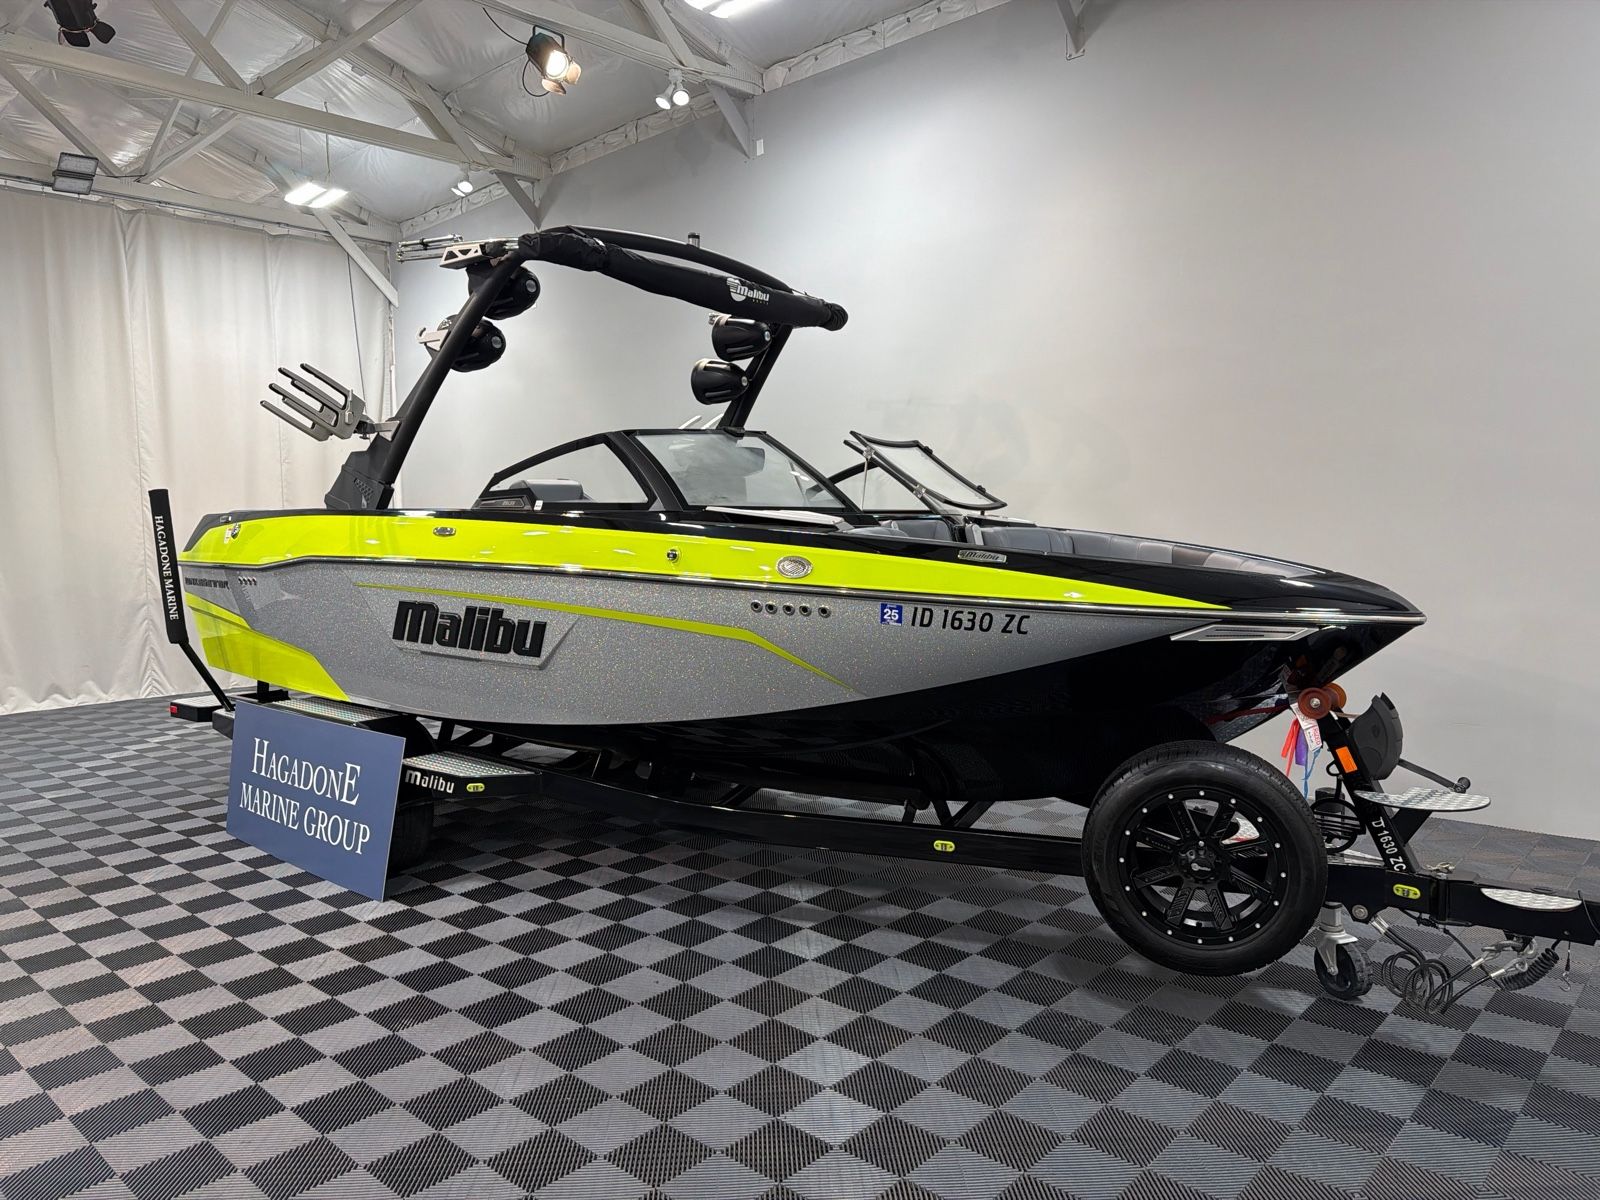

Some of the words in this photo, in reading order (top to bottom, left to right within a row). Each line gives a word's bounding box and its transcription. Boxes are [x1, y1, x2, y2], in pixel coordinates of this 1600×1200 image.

[737, 286, 769, 301] Malibu
[154, 515, 172, 577] HAGADONE
[164, 578, 180, 621] MARINE
[392, 600, 547, 658] Malibu
[883, 608, 899, 621] 25
[911, 606, 934, 628] ID
[941, 609, 994, 633] 1630
[1001, 614, 1030, 634] ZC
[251, 737, 361, 806] HAGADONE
[405, 769, 455, 794] Malibu
[239, 782, 300, 830] MARINE
[303, 806, 371, 855] GROUP
[1377, 830, 1398, 854] 1630
[1390, 856, 1406, 871] ZC
